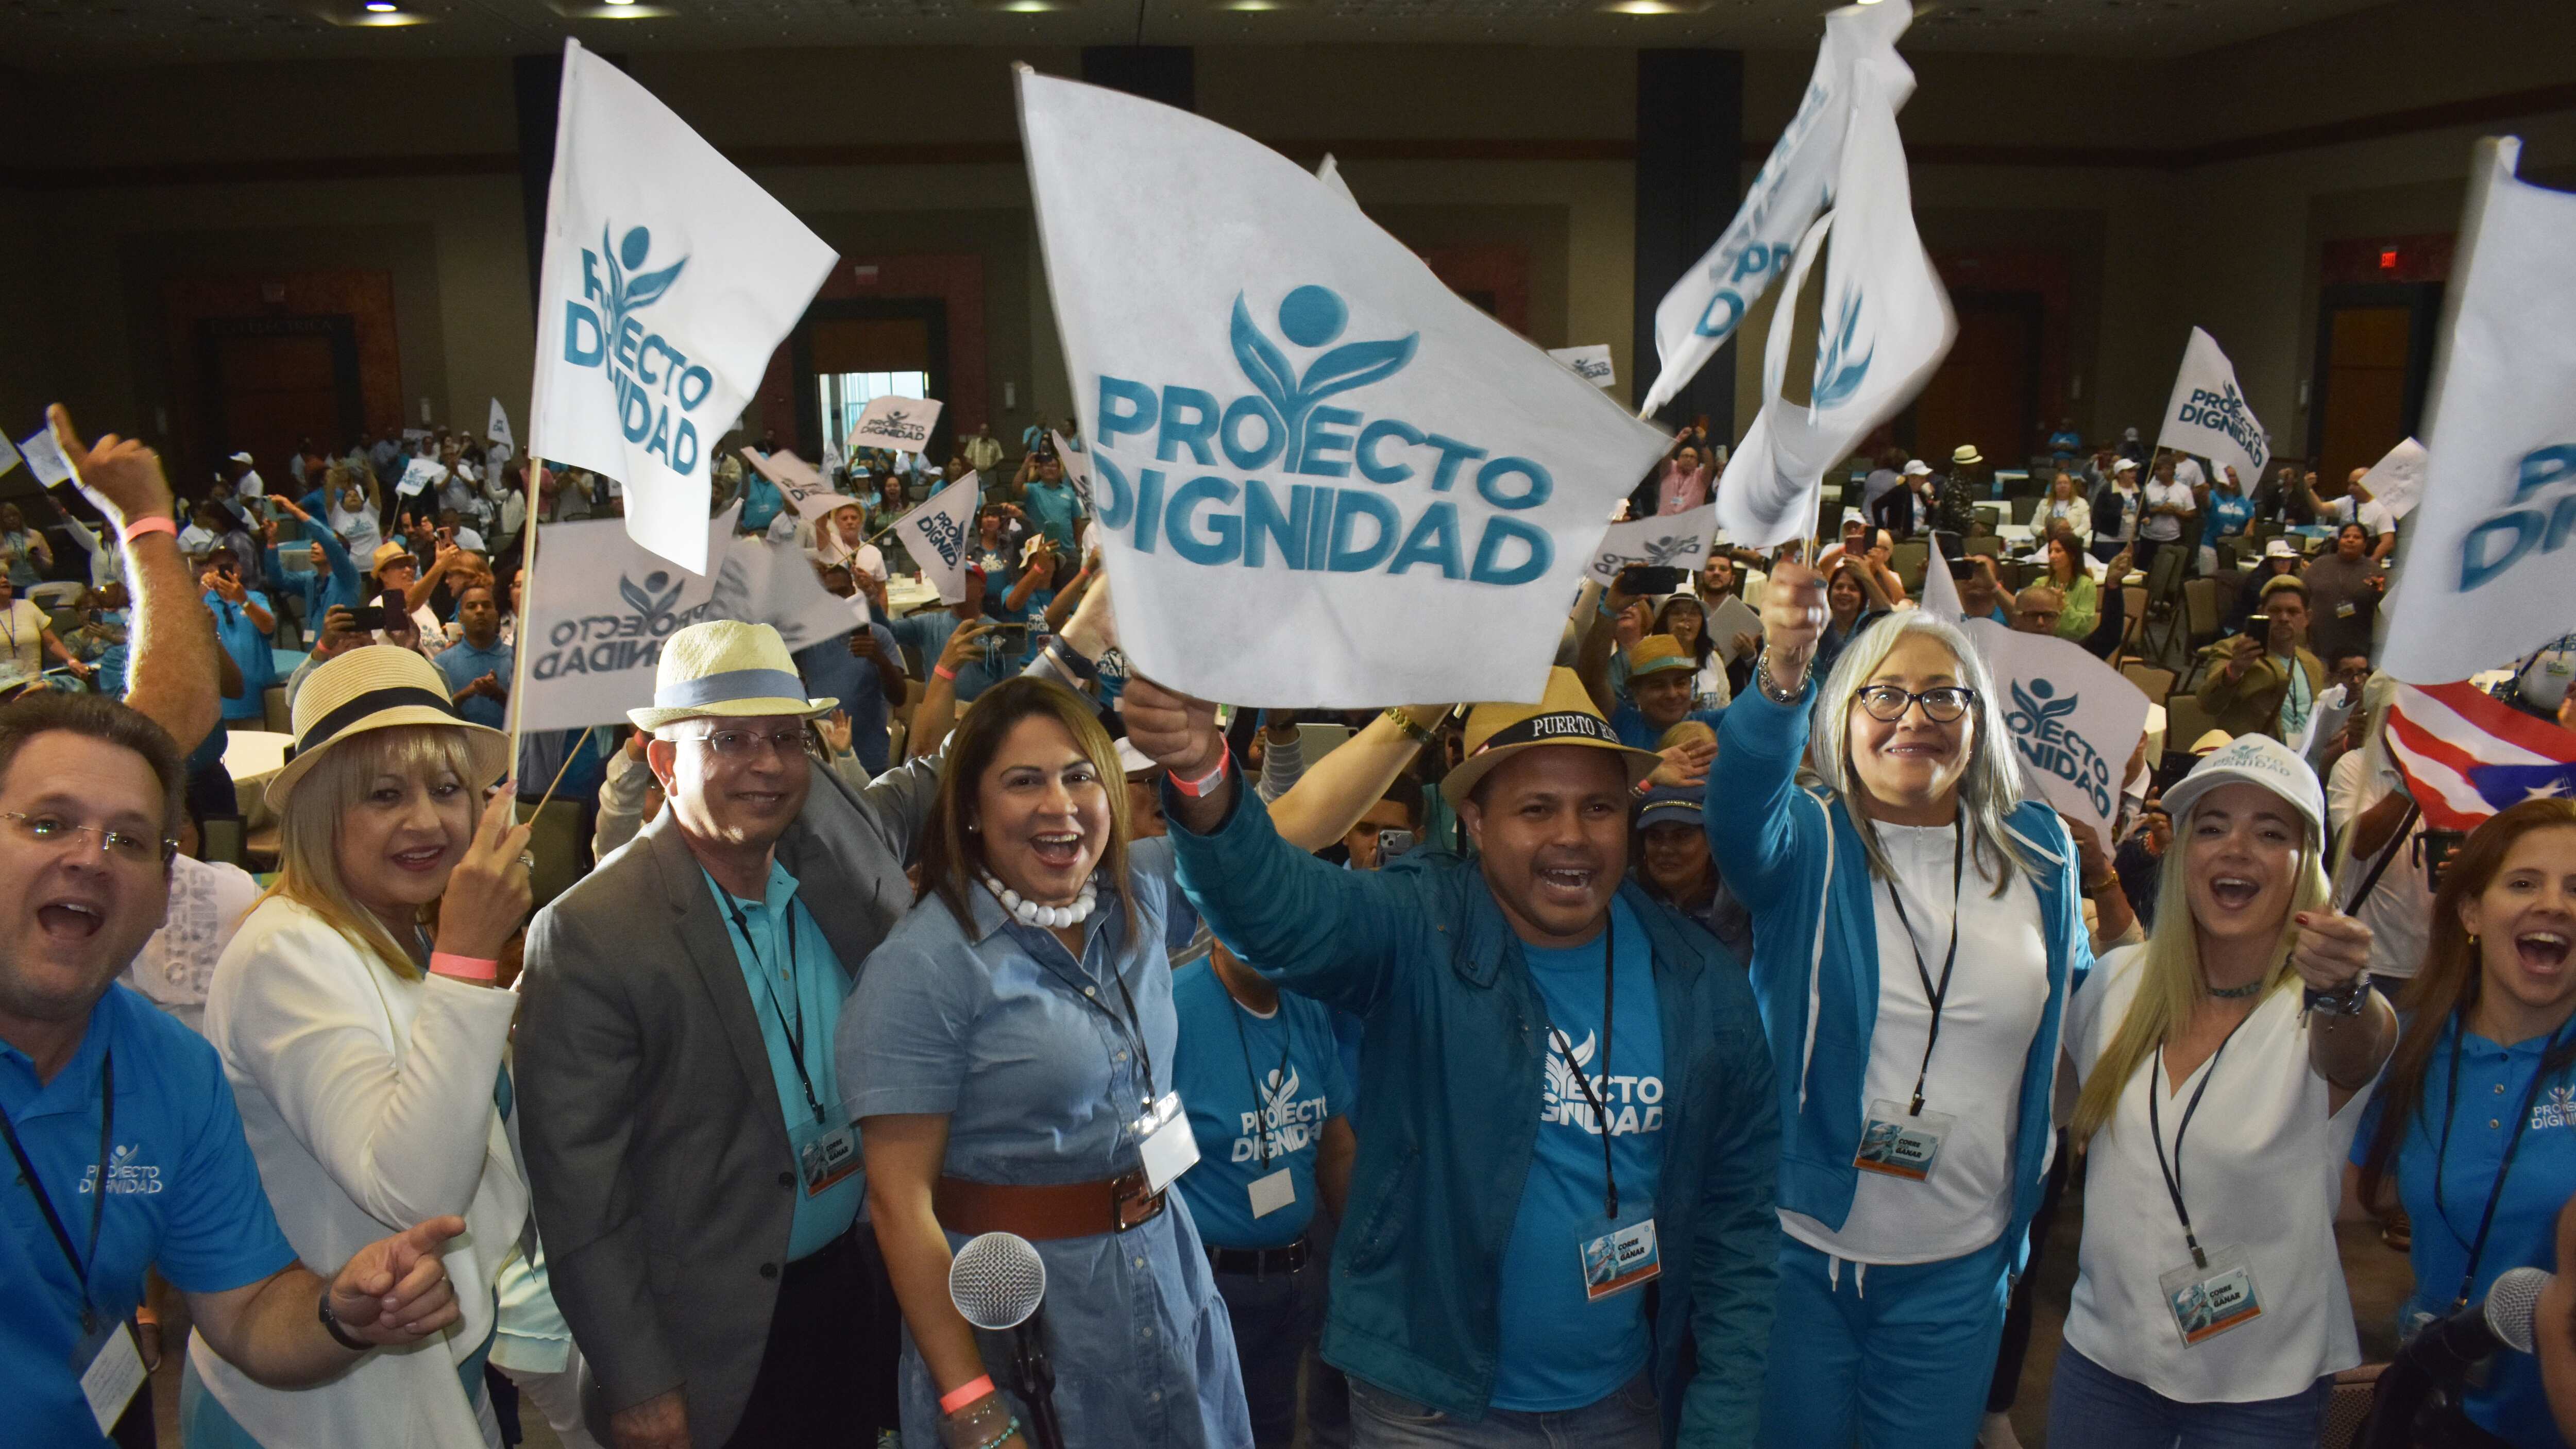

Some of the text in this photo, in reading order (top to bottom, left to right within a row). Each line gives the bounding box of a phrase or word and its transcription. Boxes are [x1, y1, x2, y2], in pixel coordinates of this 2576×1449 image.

[868, 419, 925, 432] PROYECTO
[2191, 388, 2261, 448] PROYECTO
[860, 426, 925, 440] DIGNIDAD
[2178, 403, 2263, 468] DIGNIDAD
[1098, 375, 1553, 510] PROYECTO
[1093, 447, 1555, 586] DIGNIDAD
[1532, 715, 1595, 737] PUERTO
[1899, 1138, 1921, 1148] CORRE
[1895, 1148, 1922, 1158] GANAR
[1618, 1238, 1639, 1251] CORRE
[1620, 1247, 1645, 1262] GANAR
[2210, 1284, 2232, 1298] CORRE
[2214, 1292, 2241, 1307] GANAR
